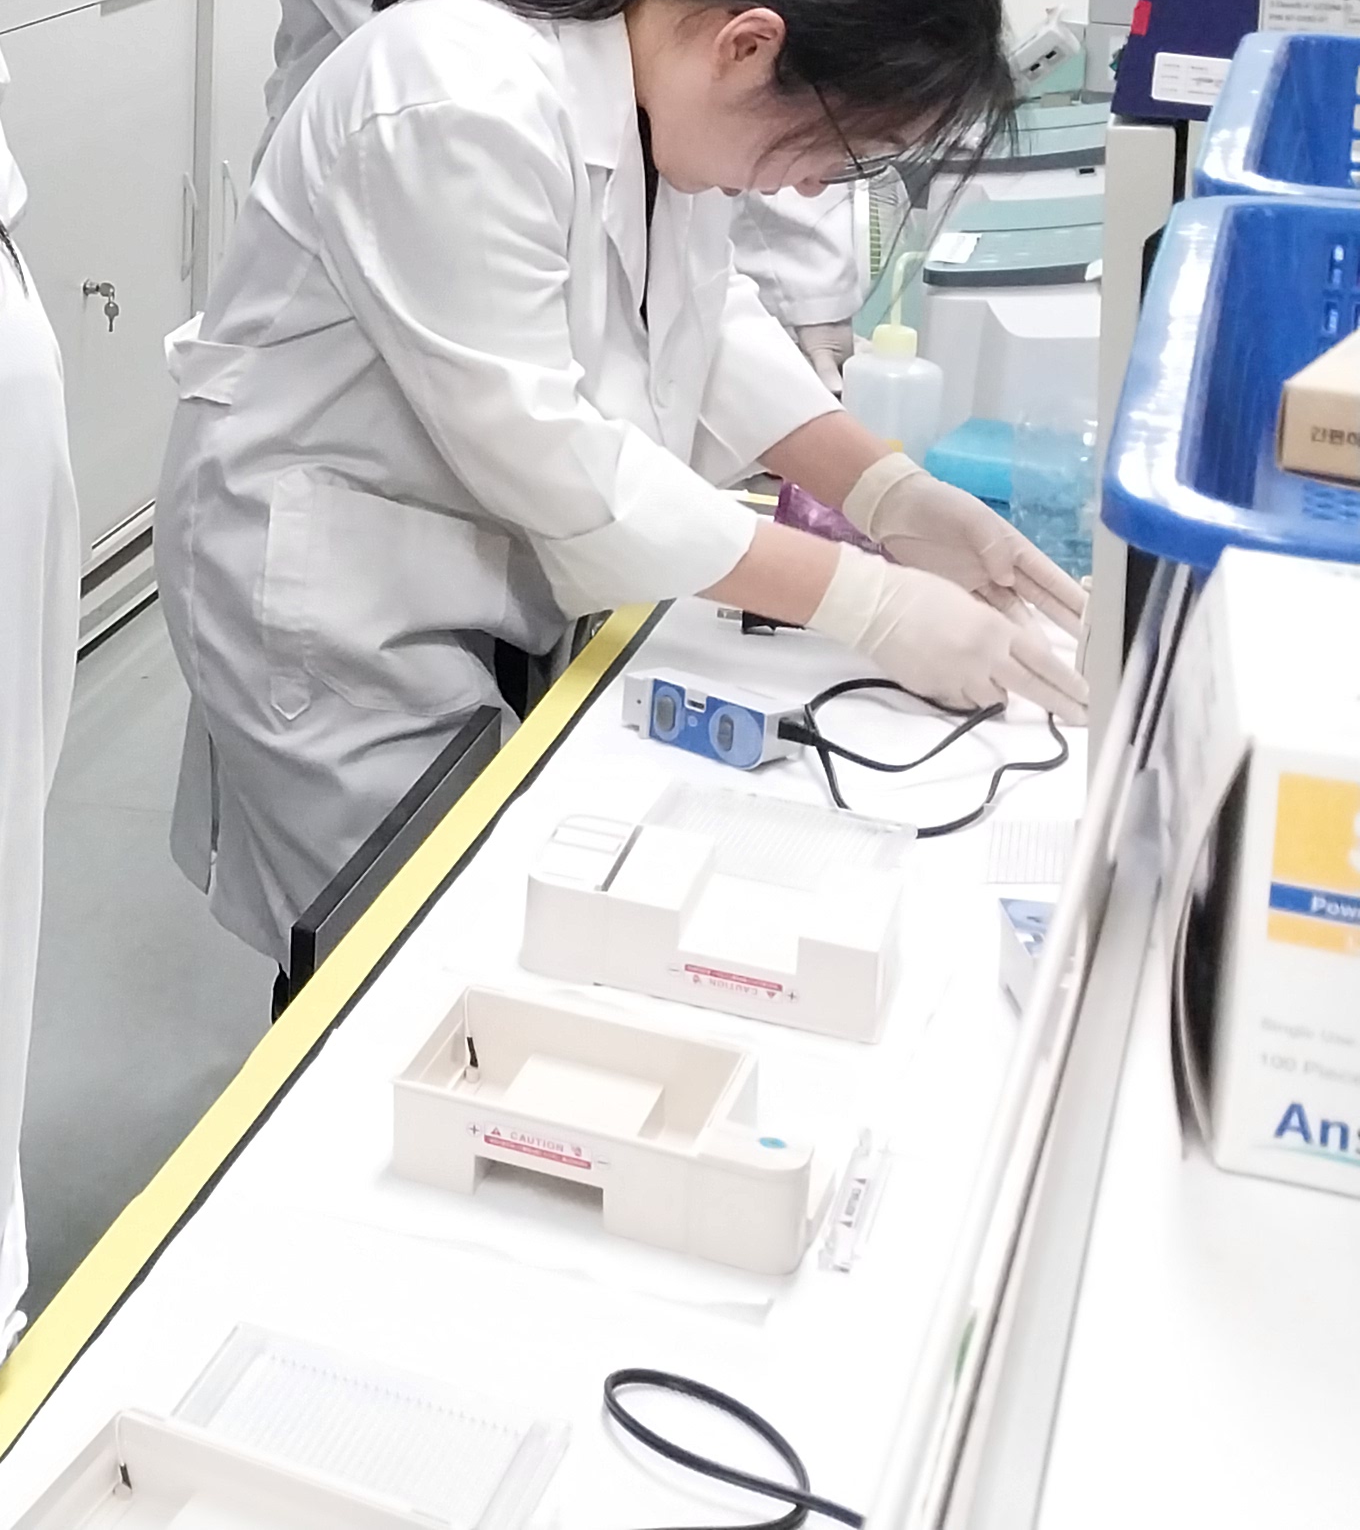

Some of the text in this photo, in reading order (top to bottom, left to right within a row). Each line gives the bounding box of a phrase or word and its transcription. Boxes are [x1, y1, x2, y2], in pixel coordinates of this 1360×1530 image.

[1311, 894, 1360, 920] Pow
[709, 978, 758, 996] CAUTION
[509, 1131, 565, 1153] CAUTION
